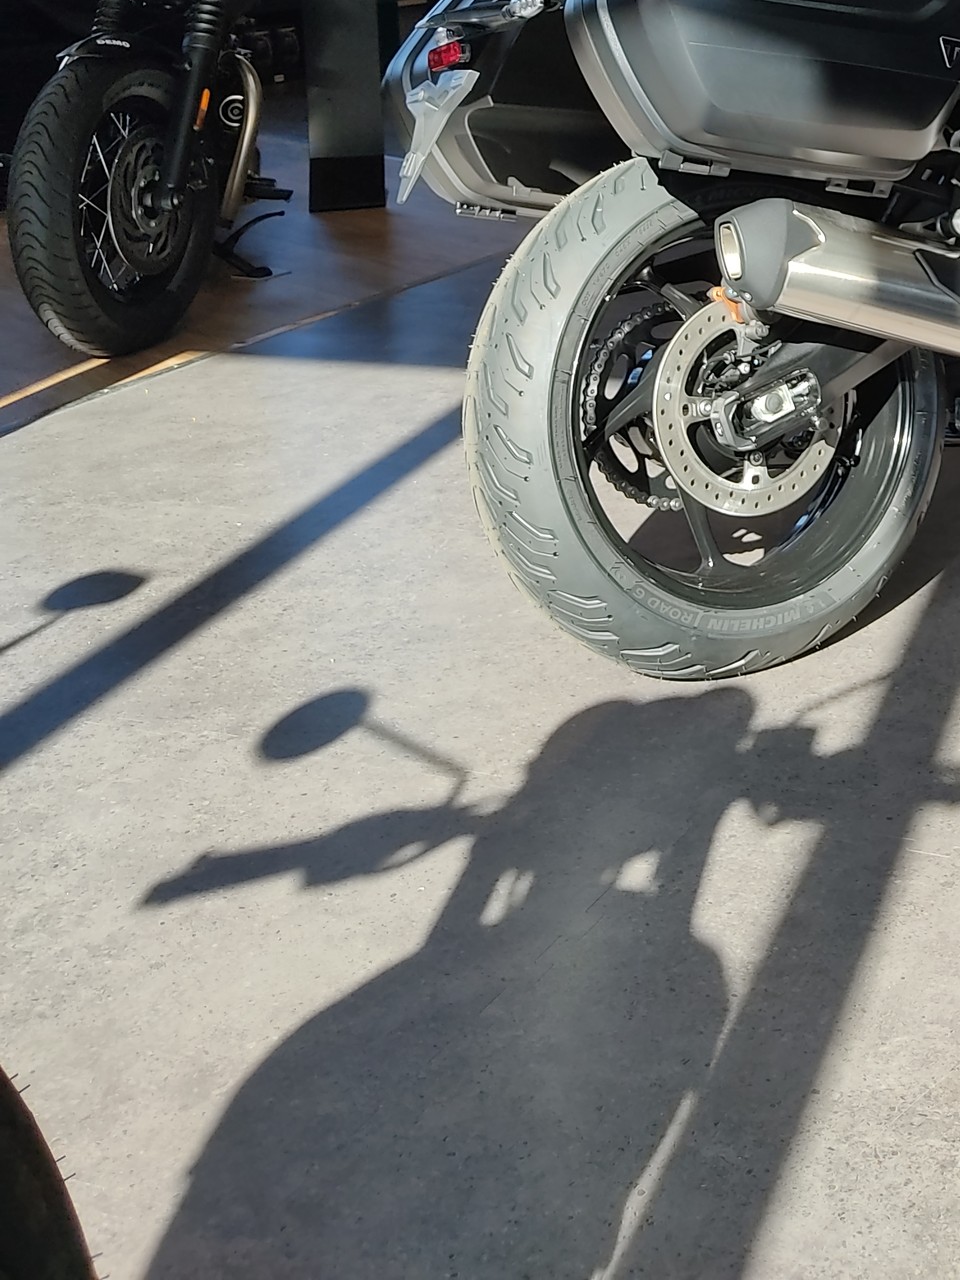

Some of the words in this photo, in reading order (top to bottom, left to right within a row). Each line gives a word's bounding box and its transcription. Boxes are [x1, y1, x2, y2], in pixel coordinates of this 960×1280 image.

[96, 39, 131, 48] DEMO
[647, 596, 694, 623] ROAD
[706, 607, 801, 632] MICHELIN
